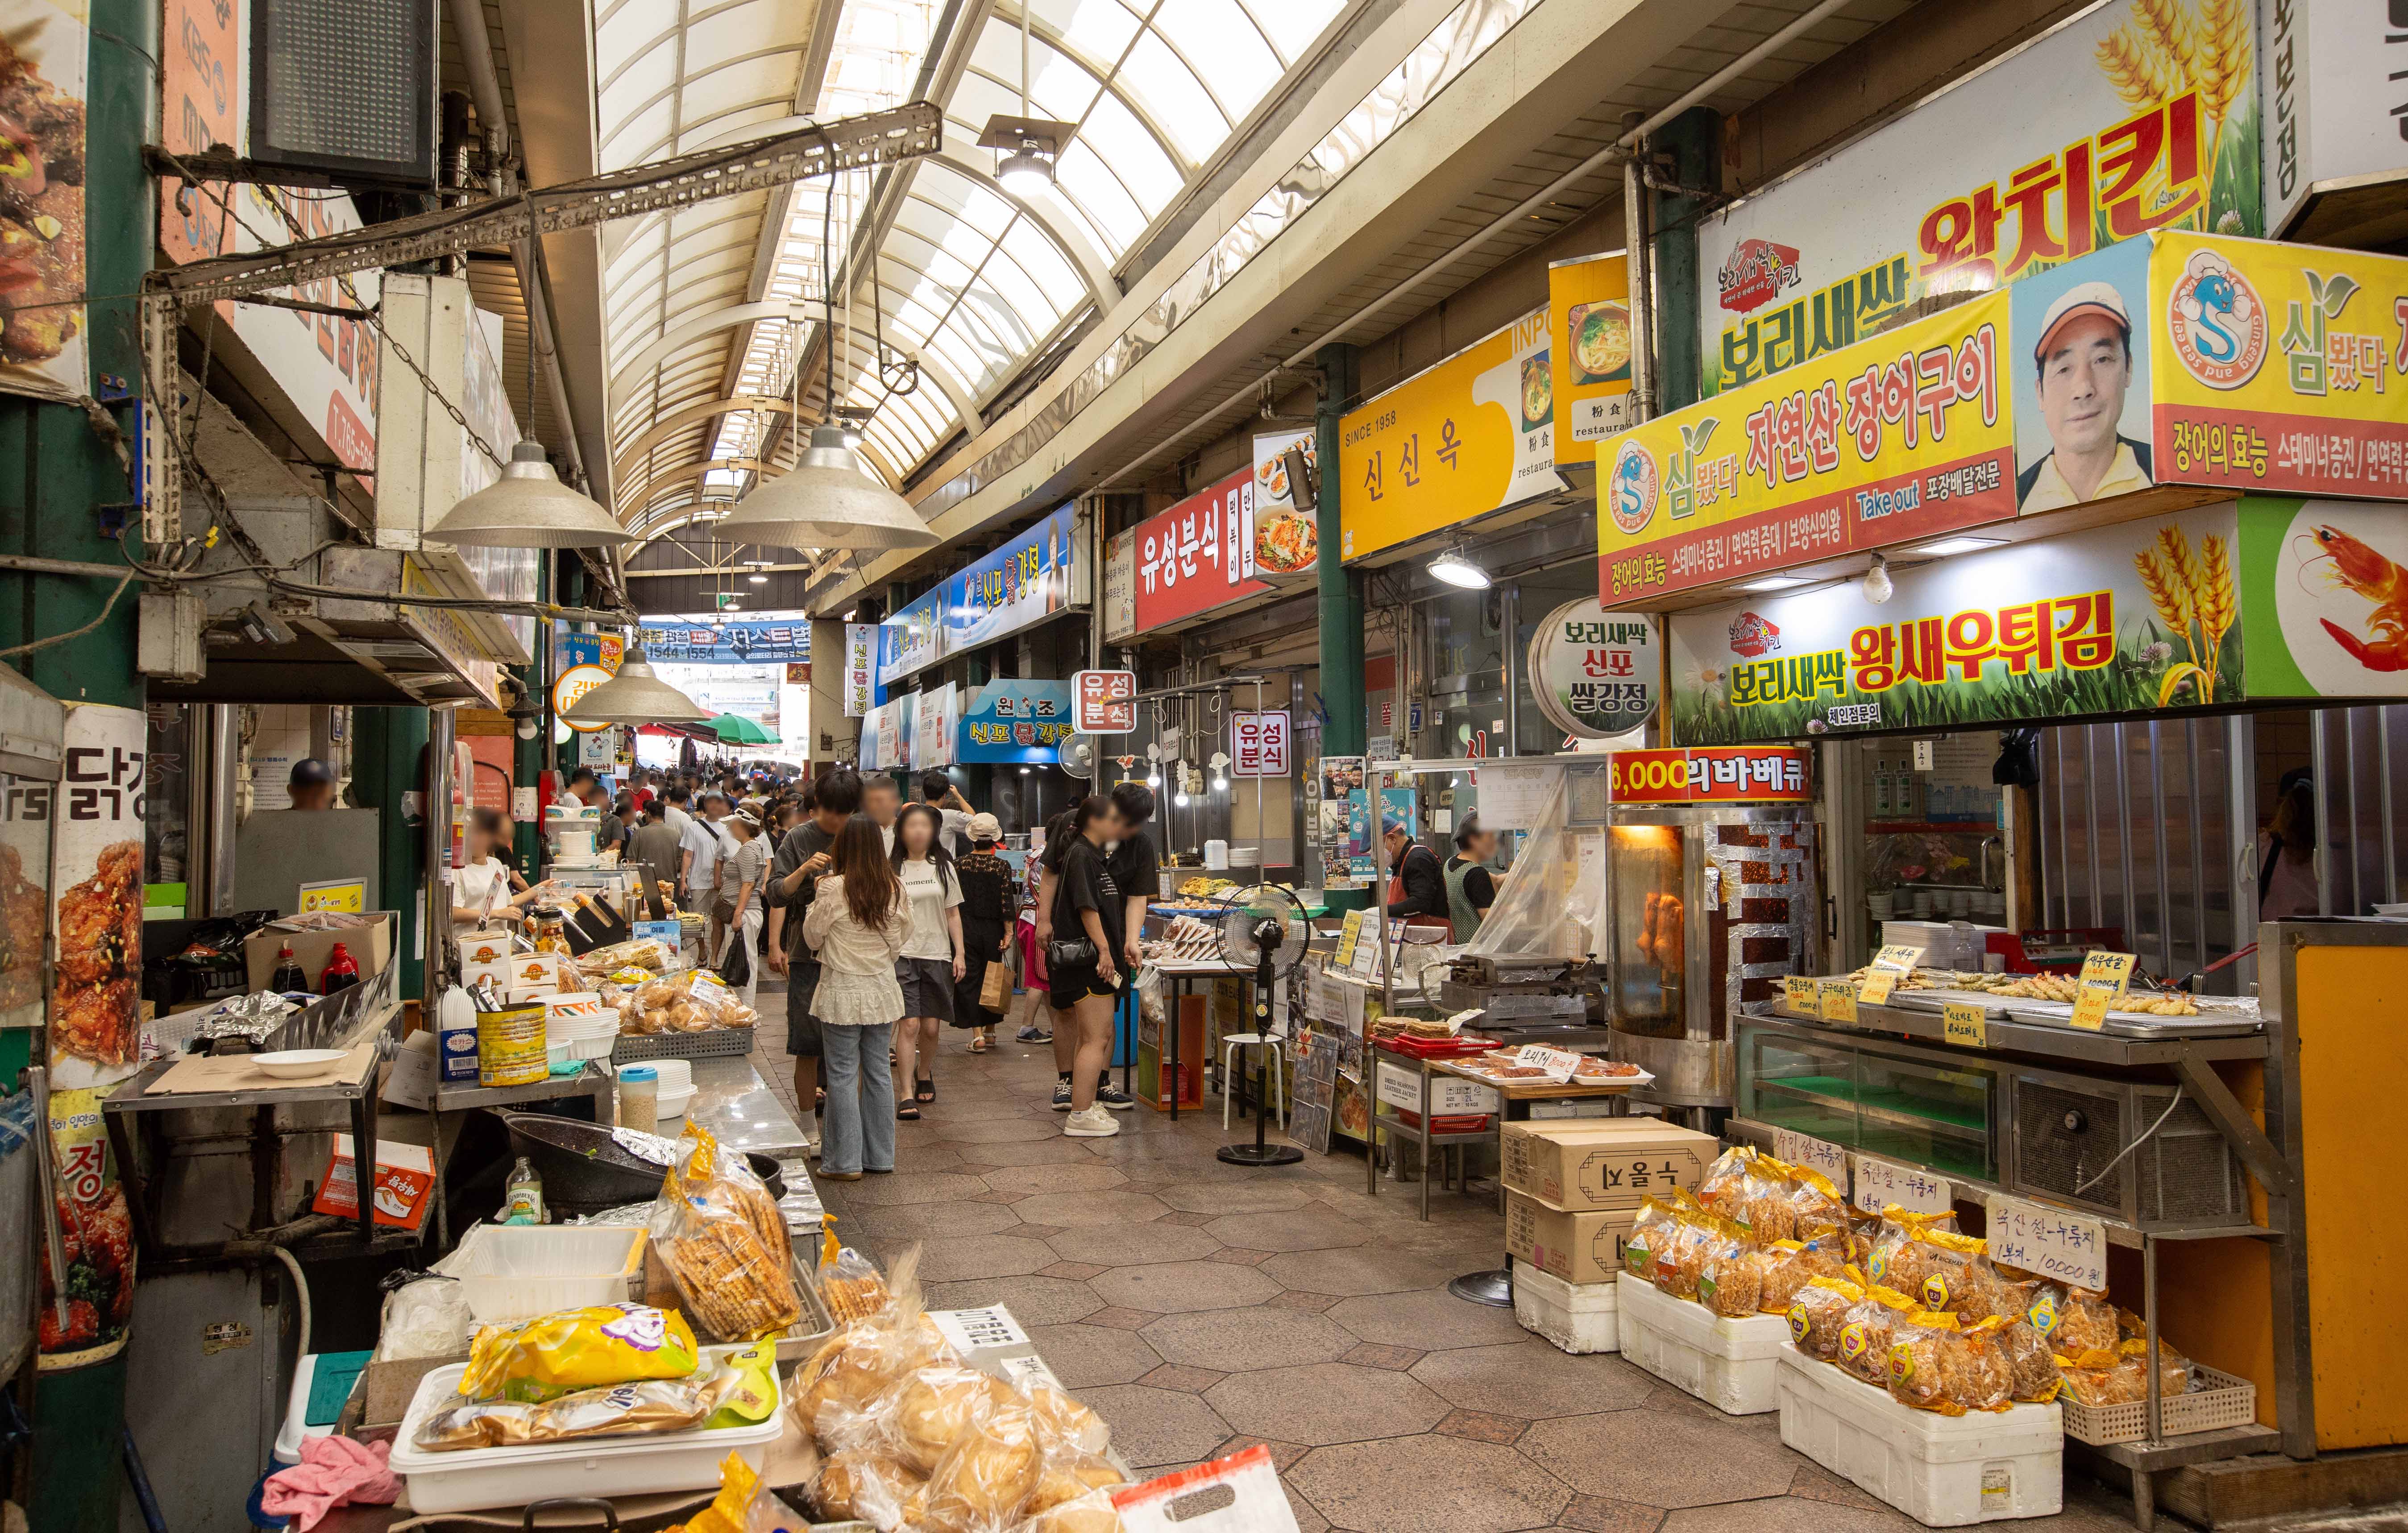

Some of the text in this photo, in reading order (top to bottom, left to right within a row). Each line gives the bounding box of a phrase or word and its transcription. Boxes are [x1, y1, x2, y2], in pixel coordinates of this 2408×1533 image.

[1718, 243, 1773, 293] 보리새싹
[1719, 255, 1911, 391] 보리새싹
[2172, 315, 2263, 380] Ginseng and sea eel
[2278, 300, 2389, 397] 심봤다
[1591, 402, 1621, 418] 粉食
[1663, 322, 1997, 520] 심봤다 자연산 장어구이
[1345, 410, 1397, 448] SINCE 1958
[1528, 431, 1549, 453] 粉食
[2173, 420, 2229, 475] 장어의
[2231, 424, 2269, 478] 효능
[2277, 431, 2355, 479] 스테미너증진
[1644, 473, 1656, 514] Ginseng
[1611, 556, 1643, 597] 장어의
[1644, 551, 1667, 586] 효능
[1856, 489, 1891, 522] Take
[1893, 479, 1920, 512] out
[1926, 459, 2001, 501] 포장배달전문
[1613, 505, 1625, 523] sea
[1626, 517, 1642, 529] and
[1140, 498, 1219, 597] 유성분식
[1565, 622, 1647, 645] 보리새싹
[1729, 617, 1764, 642] 보리새싹
[1731, 589, 2114, 706] 보리새싹 왕새우튀김
[1582, 649, 1634, 678] 신포
[1569, 683, 1648, 713] 쌀강정
[1828, 703, 1881, 726] 체인점문의
[1240, 723, 1281, 746] 유성
[1240, 747, 1282, 769] 분식
[1442, 794, 1452, 802] OPEN
[1384, 1084, 1417, 1099] LEATHER JACKET
[1385, 1077, 1417, 1092] DRIED SEASONED
[62, 1139, 109, 1202] 정
[1603, 1161, 1679, 1190] 누룽지
